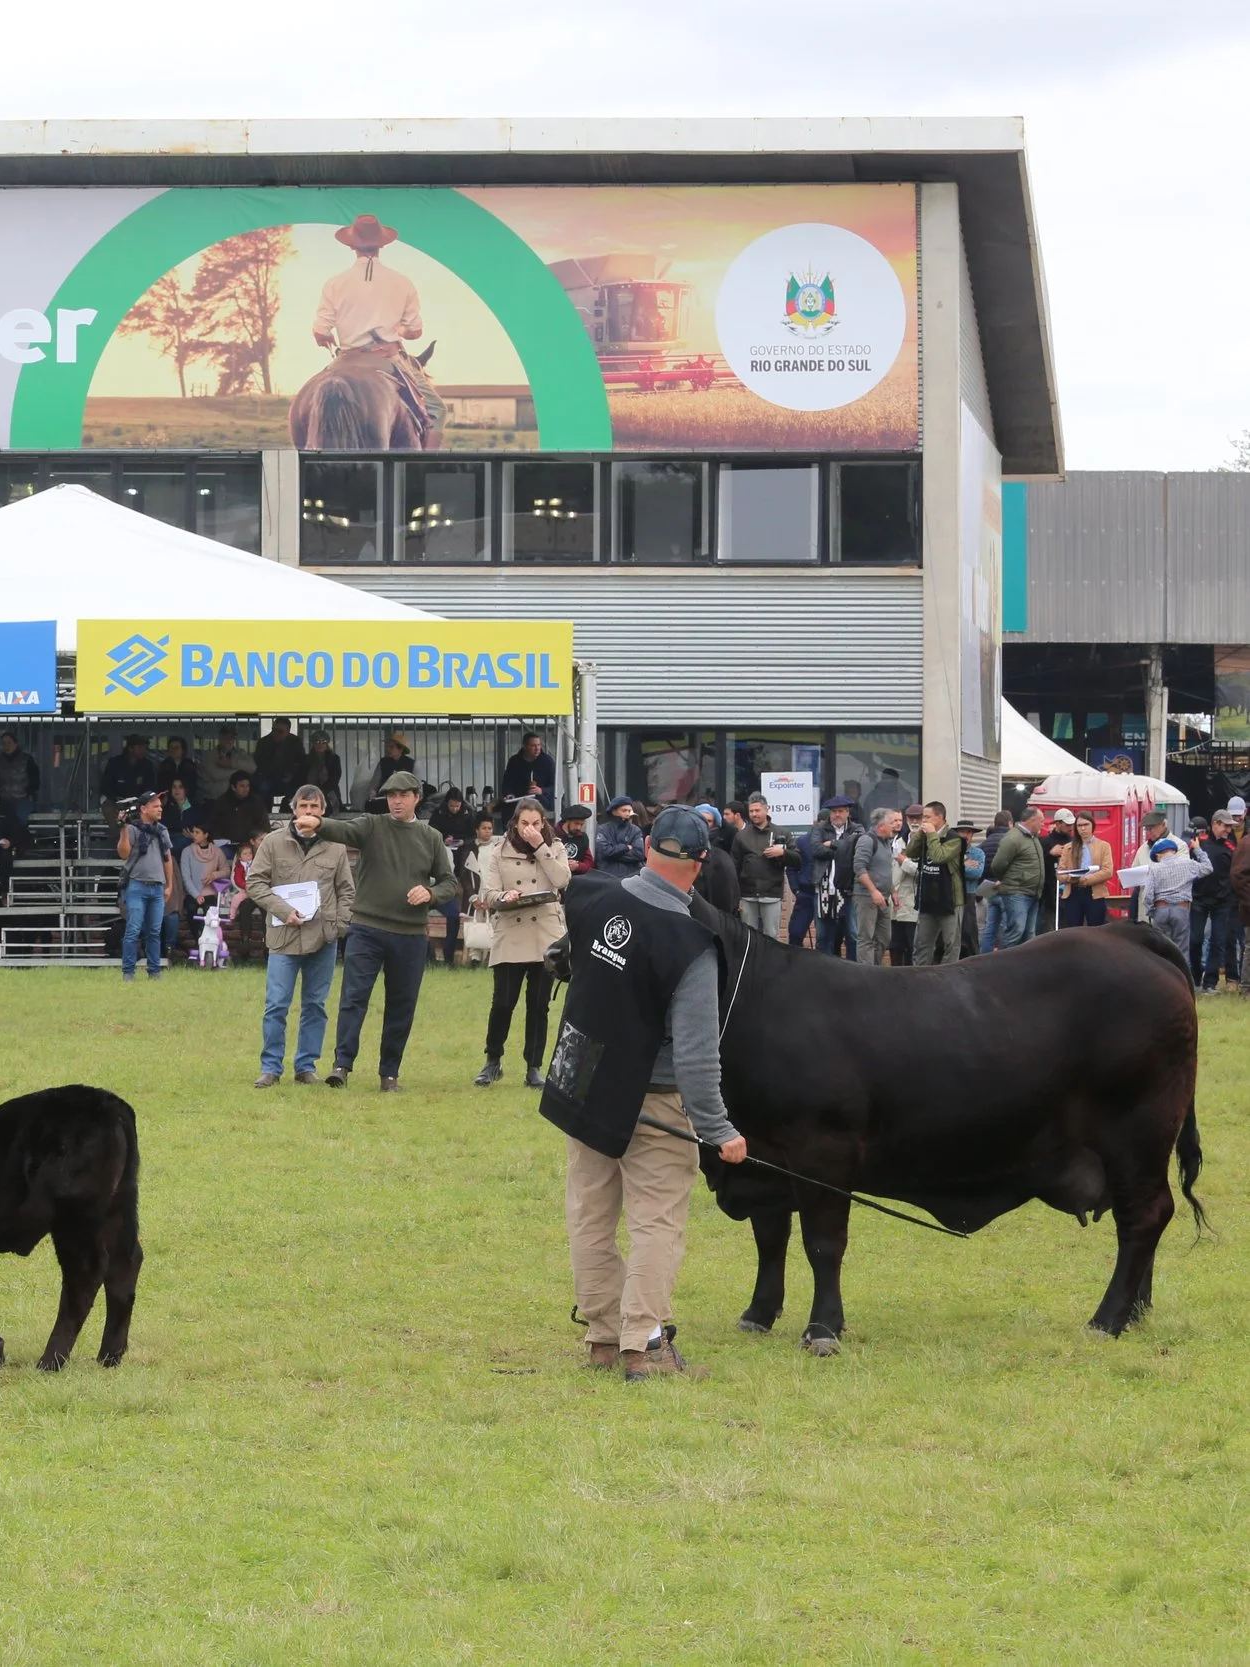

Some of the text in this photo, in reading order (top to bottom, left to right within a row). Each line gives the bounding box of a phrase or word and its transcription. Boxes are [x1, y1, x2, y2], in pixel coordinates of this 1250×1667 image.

[750, 345, 872, 356] GOVERNO DO ESTADO
[750, 360, 872, 372] RIO GRANDE DO SUL
[180, 643, 560, 689] BANCO DO BRASIL
[769, 781, 804, 790] Expointer
[798, 804, 811, 812] 06
[591, 939, 626, 966] Brangus
